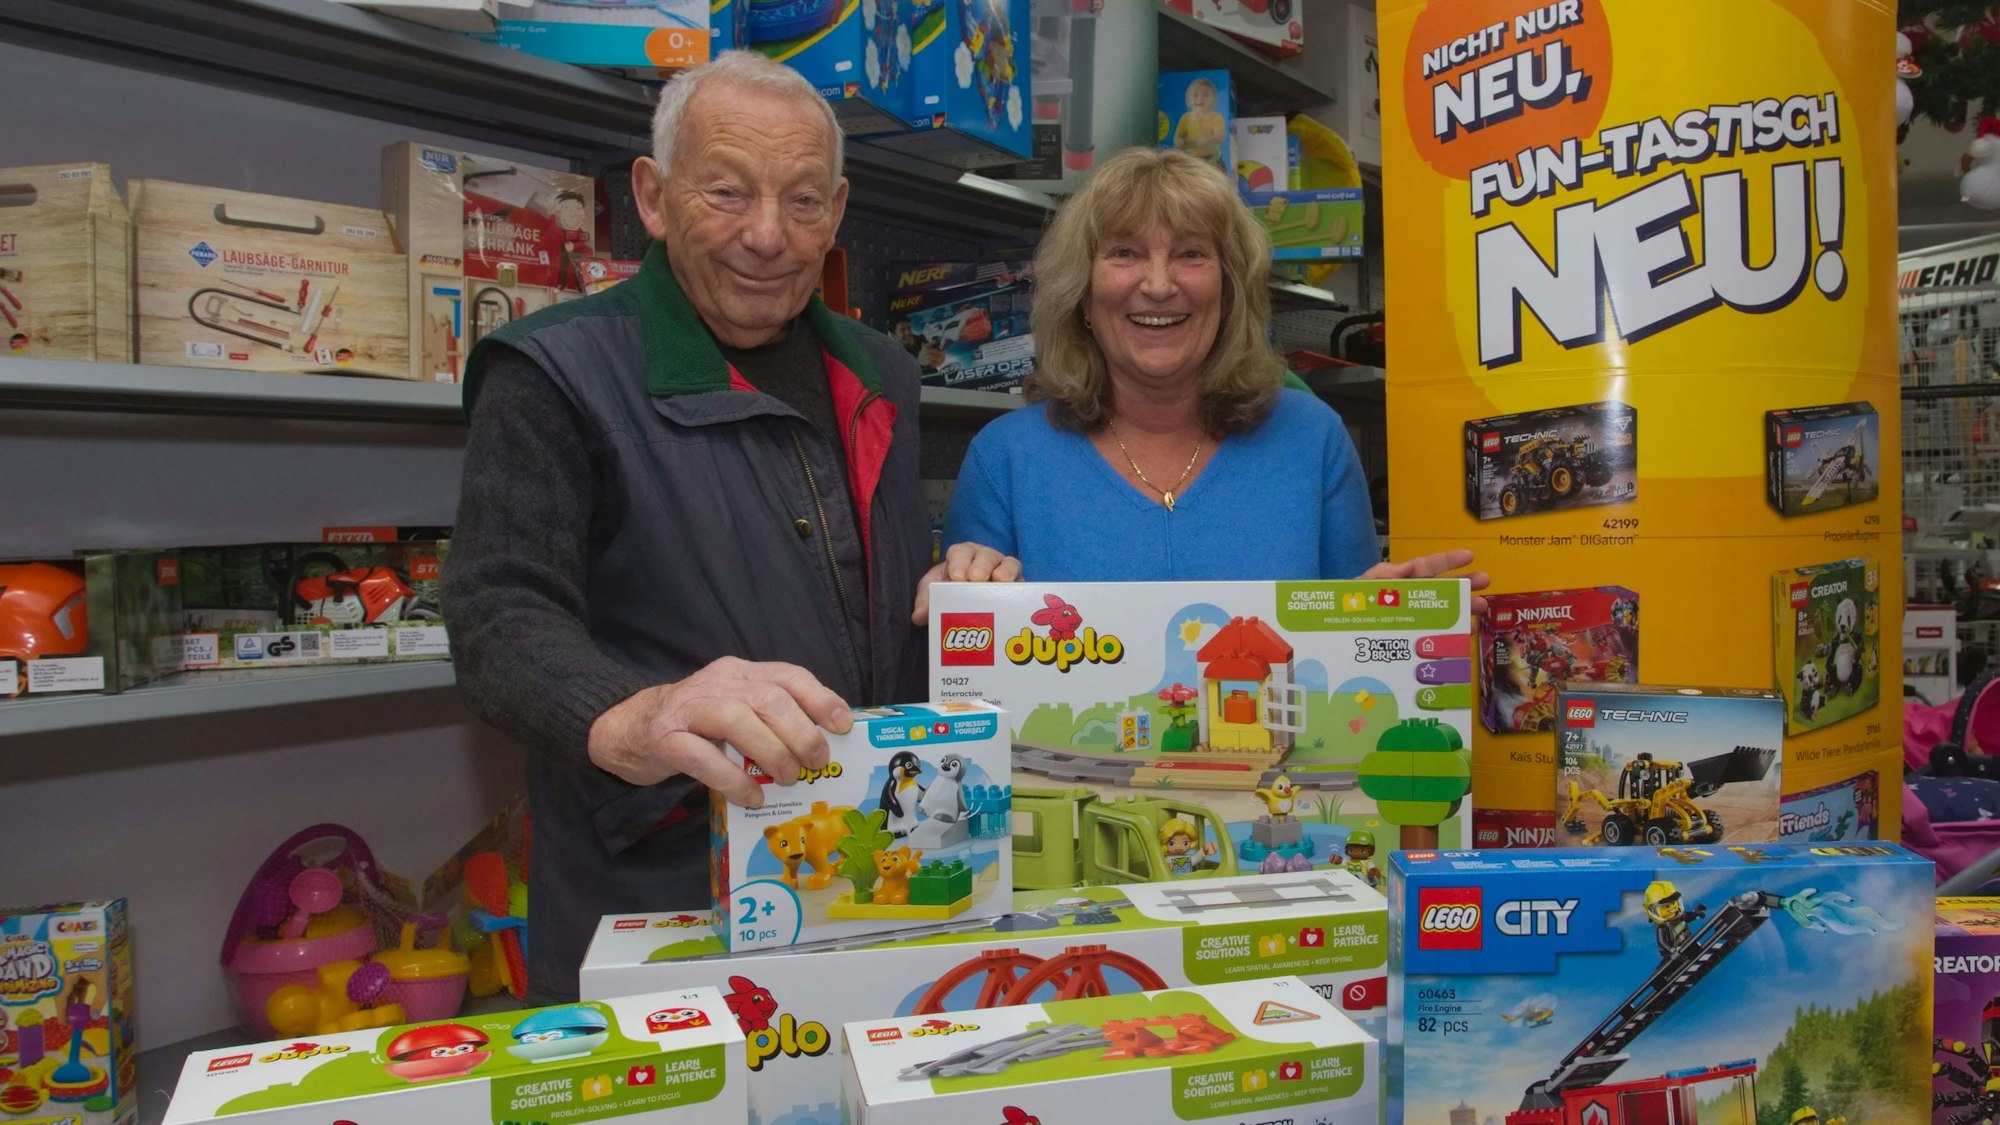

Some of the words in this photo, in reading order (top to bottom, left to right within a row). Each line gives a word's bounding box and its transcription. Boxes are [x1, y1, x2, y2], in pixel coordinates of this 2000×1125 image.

[1421, 23, 1505, 79] NICHT
[1514, 0, 1584, 41] NUR
[1433, 39, 1593, 143] NEU,
[1470, 91, 1840, 218] FUN-TASTISCH
[468, 236, 536, 256] SCHRANK
[223, 249, 349, 276] LAUBSÄGE-GARNITUR
[1474, 157, 1848, 370] NEU!
[897, 266, 952, 289] NERF
[1917, 253, 1999, 288] ECHO
[889, 294, 925, 311] NERF
[944, 365, 995, 383] LASER
[997, 357, 1034, 373] OPS
[1483, 436, 1501, 448] LEGO
[1503, 429, 1559, 444] TECHNIC
[1804, 427, 1842, 440] TECHNIC
[1602, 518, 1639, 530] 42199
[1499, 534, 1545, 546] Monster
[1291, 590, 1335, 601] CREATIVE
[1408, 589, 1438, 600] LEARN
[1811, 580, 1848, 599] CREATOR
[1287, 600, 1335, 611] SOLUTIONS
[1408, 599, 1449, 609] PATIENCE
[1323, 616, 1376, 624] PROBLEM-SOLVING
[1496, 612, 1512, 622] LEGO
[1514, 605, 1576, 625] NINJAGO
[943, 628, 992, 651] LEGO
[1005, 626, 1125, 673] duplo
[1354, 637, 1372, 663] 3
[1370, 638, 1409, 651] ACTION
[1371, 648, 1412, 663] BRICKS
[941, 676, 970, 687] 10427
[941, 690, 984, 698] Interactive
[1568, 707, 1594, 719] LEGO
[1601, 709, 1688, 724] TECHNIC
[953, 719, 991, 729] EXPRESSING
[955, 726, 986, 736] YOURSELF
[875, 733, 906, 741] THINKING
[1565, 731, 1580, 742] 7+
[1510, 751, 1533, 763] Kais
[1535, 753, 1554, 764] Stu
[1565, 757, 1578, 766] 104
[1796, 749, 1821, 761] Wilde
[1564, 766, 1581, 777] pcs
[745, 810, 771, 819] Penguins
[778, 809, 793, 817] Lions
[1779, 801, 1831, 836] Friends
[1478, 830, 1499, 841] LEGO
[1443, 850, 1481, 858] CITY
[738, 896, 776, 925] 2+
[1423, 905, 1478, 931] LEGO
[1494, 898, 1581, 937] CITY
[739, 929, 756, 941] 10
[758, 929, 777, 943] pcs
[1333, 924, 1365, 937] LEARN
[1200, 934, 1251, 949] CREATIVE
[1333, 934, 1380, 948] PATIENCE
[1195, 946, 1251, 961] SOLUTIONS
[1225, 965, 1246, 974] LEARN
[1246, 963, 1272, 973] SPATIAL
[1272, 959, 1310, 971] AWARENESS
[1315, 957, 1330, 965] KEEP
[1331, 955, 1354, 965] TRYING
[1418, 988, 1456, 999] 60463
[1418, 1004, 1433, 1012] Fire
[1434, 1004, 1462, 1014] Engine
[868, 1030, 899, 1040] LEGO
[908, 1023, 981, 1038] duplo
[1418, 1017, 1437, 1032] 82
[1443, 1020, 1469, 1035] pcs
[212, 1056, 251, 1069] LEGO
[258, 1045, 351, 1064] duplo
[1310, 1057, 1341, 1069] LEARN
[665, 1058, 701, 1073] LEARN
[665, 1068, 717, 1085] PATIENCE
[1188, 1071, 1235, 1086] CREATIVE
[1311, 1067, 1353, 1081] PATIENCE
[515, 1078, 573, 1097] CREATIVE
[1184, 1082, 1235, 1099] SOLUTIONS
[510, 1091, 573, 1110] SOLUTIONS
[551, 1101, 618, 1119] PROBLEM-SOLVING
[623, 1097, 647, 1109] LEARN
[647, 1094, 656, 1104] TO
[657, 1091, 681, 1102] FOCUS
